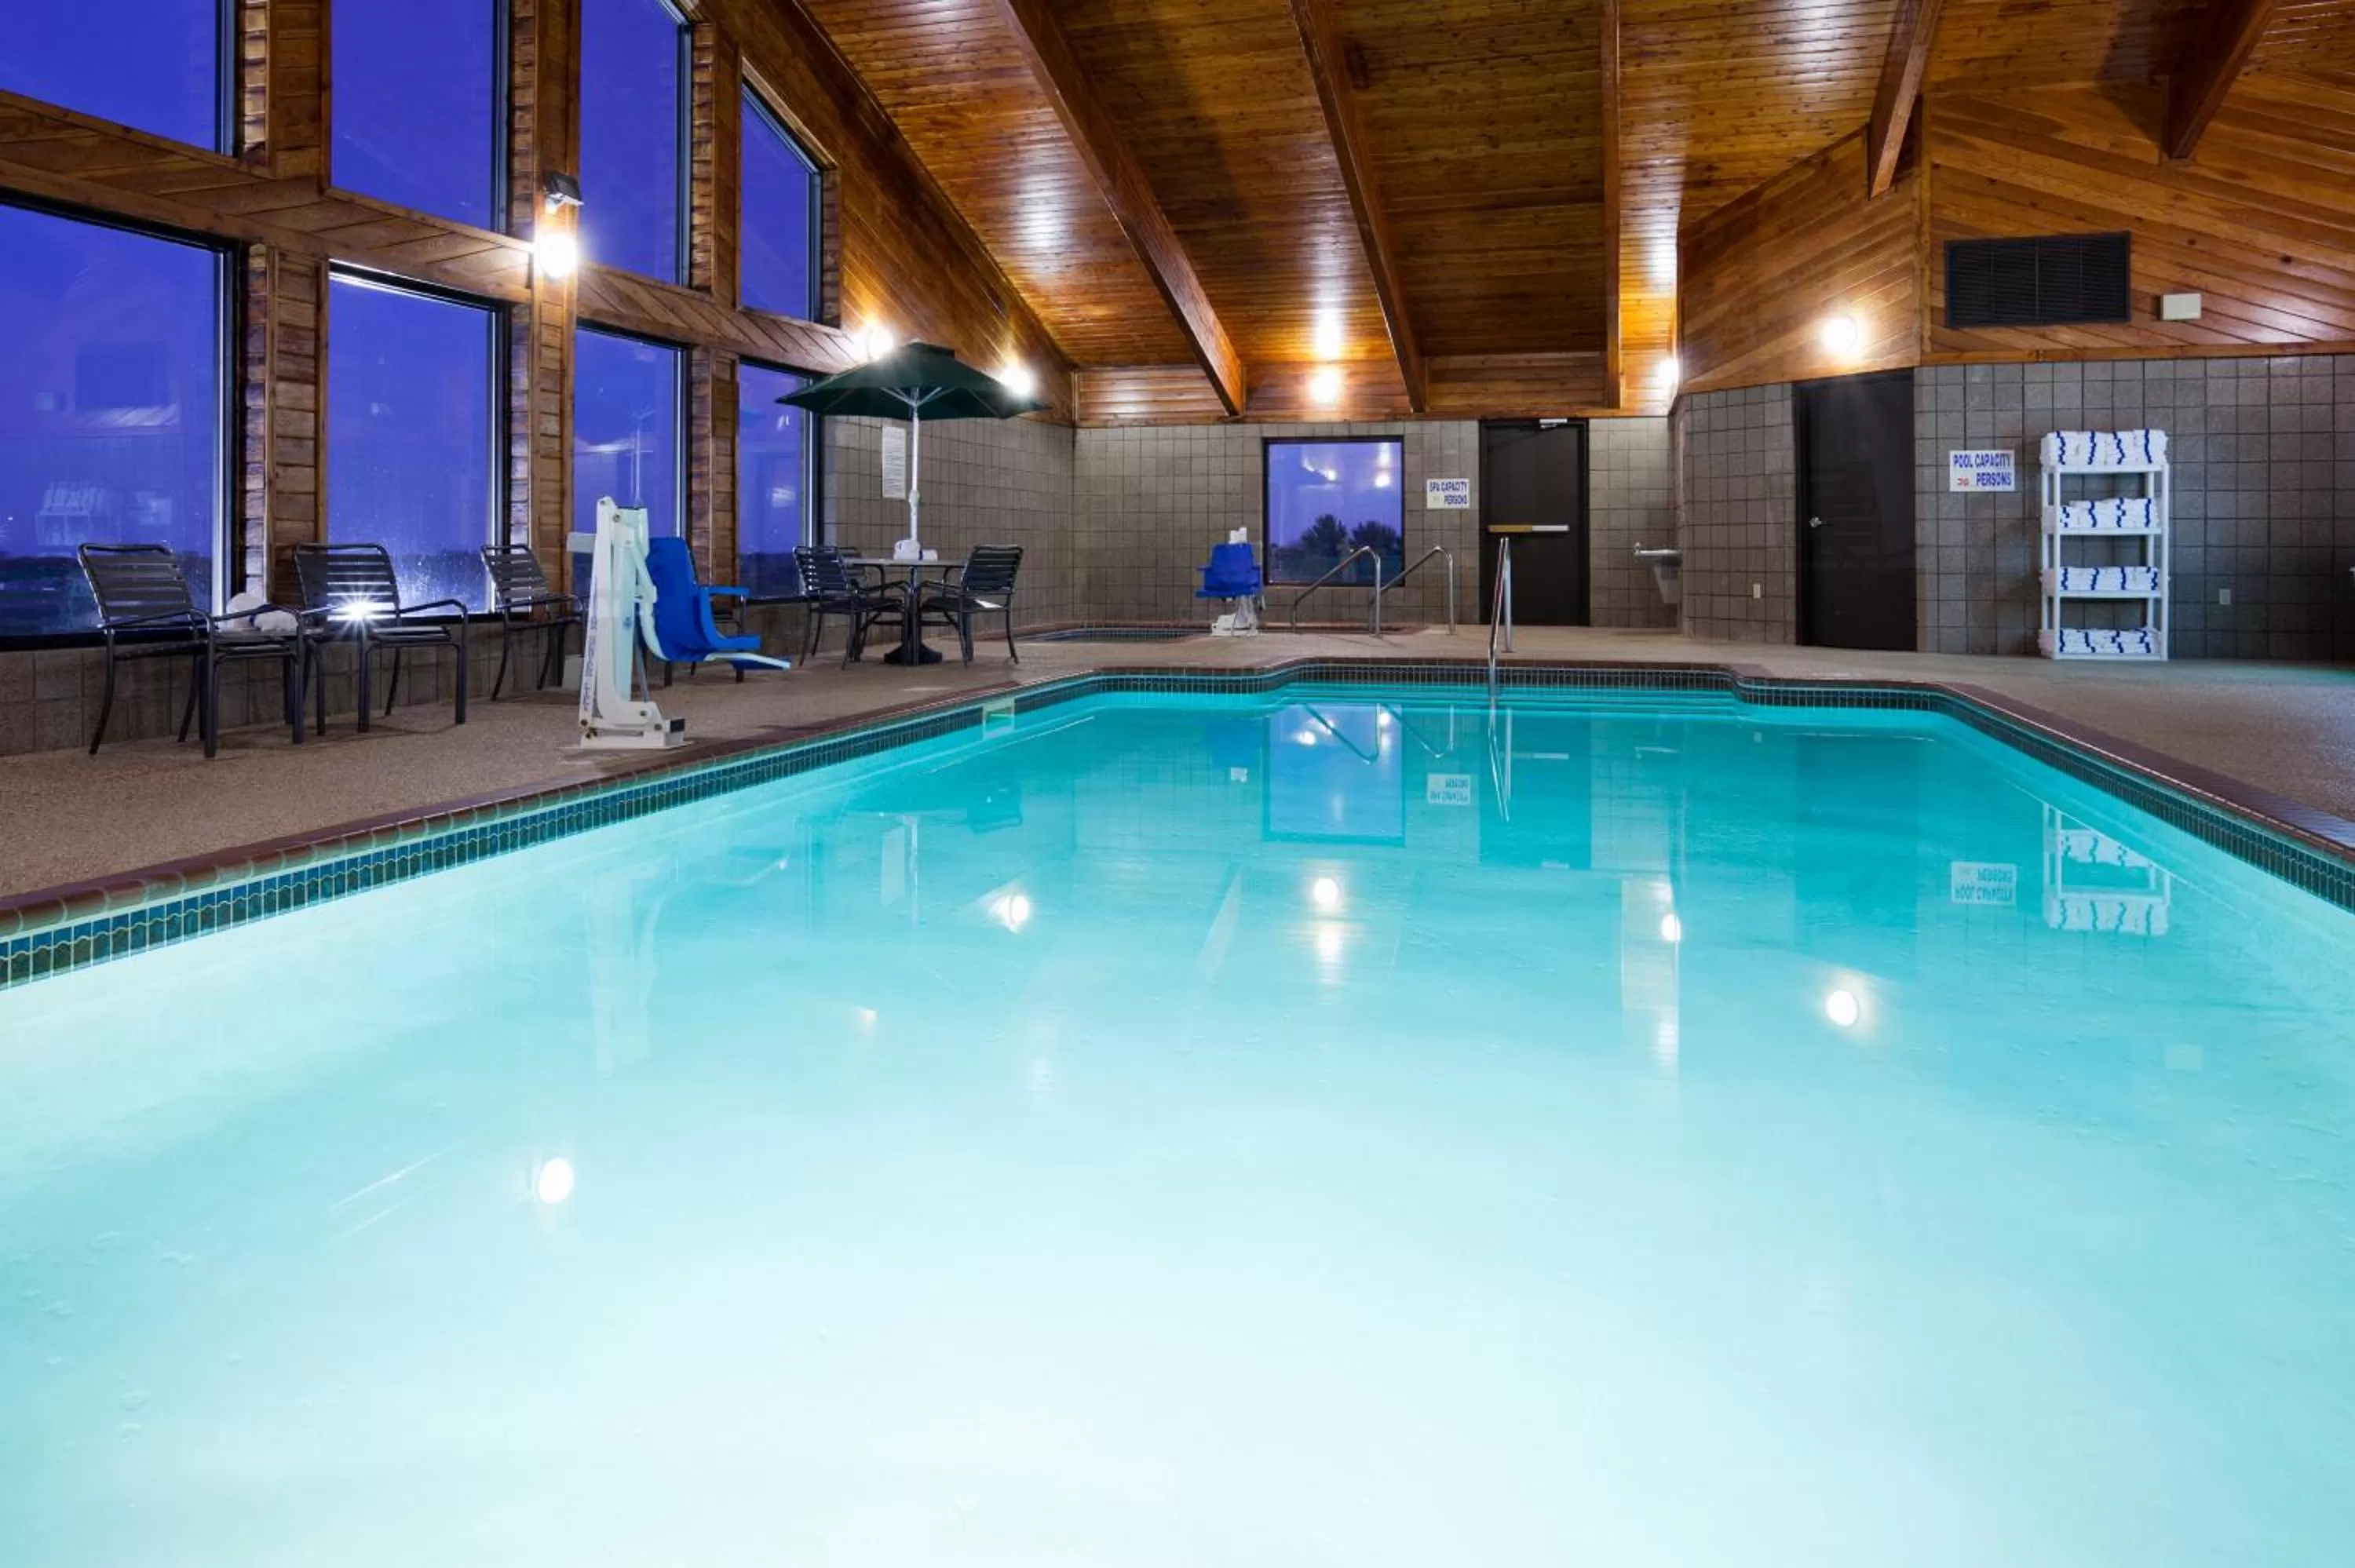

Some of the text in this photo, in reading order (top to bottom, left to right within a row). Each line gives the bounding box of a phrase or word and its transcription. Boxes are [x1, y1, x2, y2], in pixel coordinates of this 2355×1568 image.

[1953, 453, 2011, 468] POOL CAPACITY
[1976, 472, 2011, 486] PERSONS
[1441, 481, 1467, 491] CAPACITY
[1444, 494, 1467, 505] PERSONS
